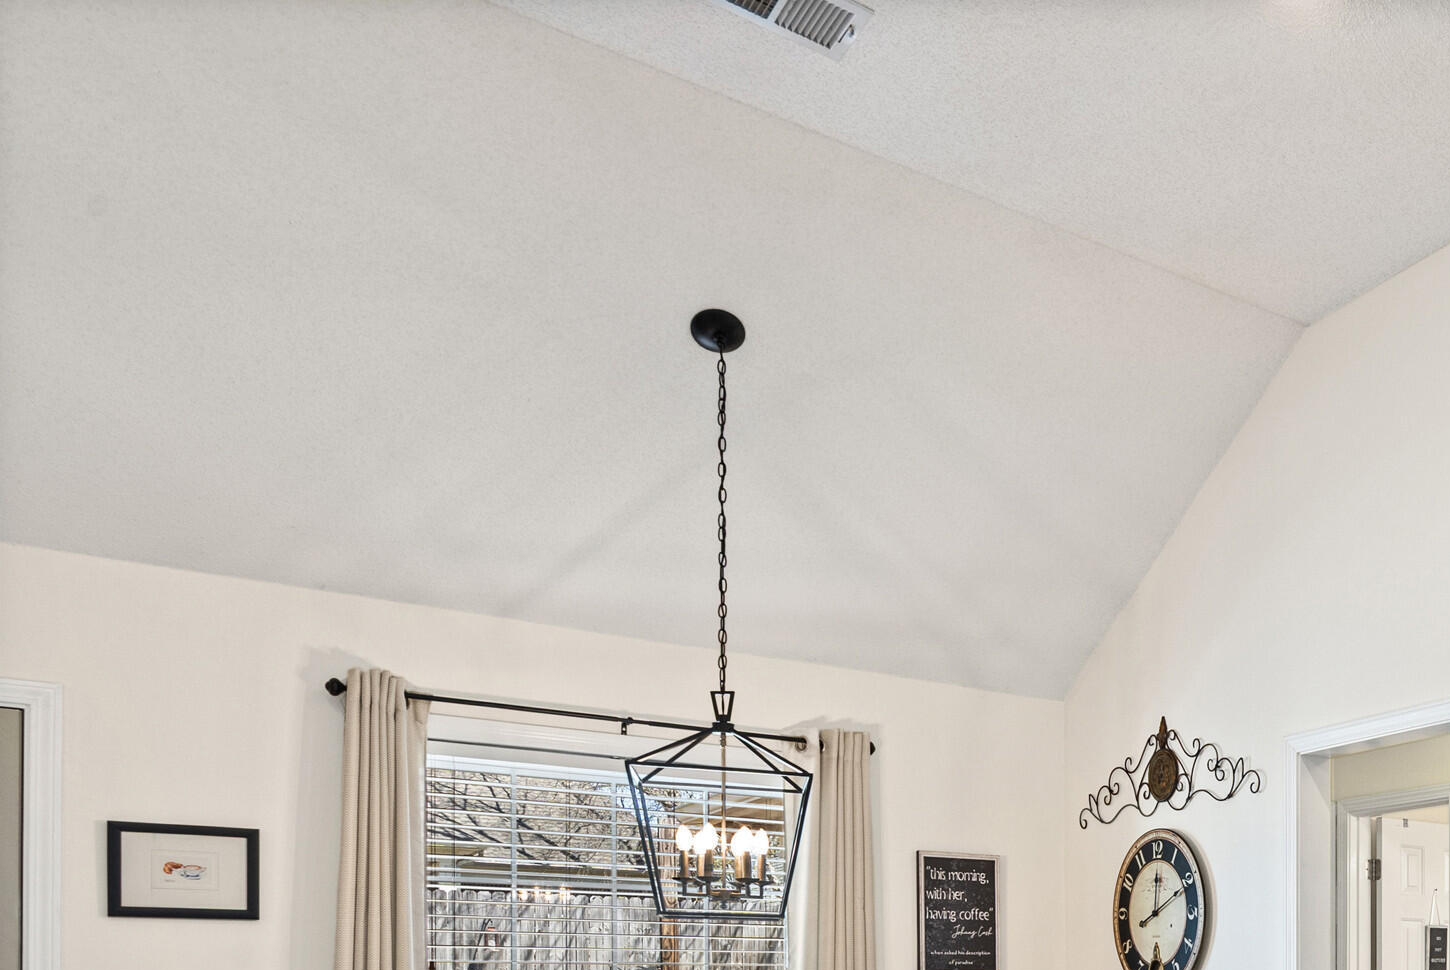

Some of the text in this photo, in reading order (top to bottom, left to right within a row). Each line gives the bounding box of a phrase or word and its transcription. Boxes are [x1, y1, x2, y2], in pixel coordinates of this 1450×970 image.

[1151, 840, 1164, 859] 12
[1171, 847, 1178, 865] 1
[1135, 849, 1146, 869] 11
[1122, 873, 1134, 892] 10
[1182, 872, 1194, 887] 2
[926, 888, 946, 900] with
[926, 907, 957, 922] having
[1119, 907, 1128, 920] 9
[1187, 904, 1198, 920] 3
[1122, 939, 1133, 954] 8
[1183, 937, 1194, 954] 4
